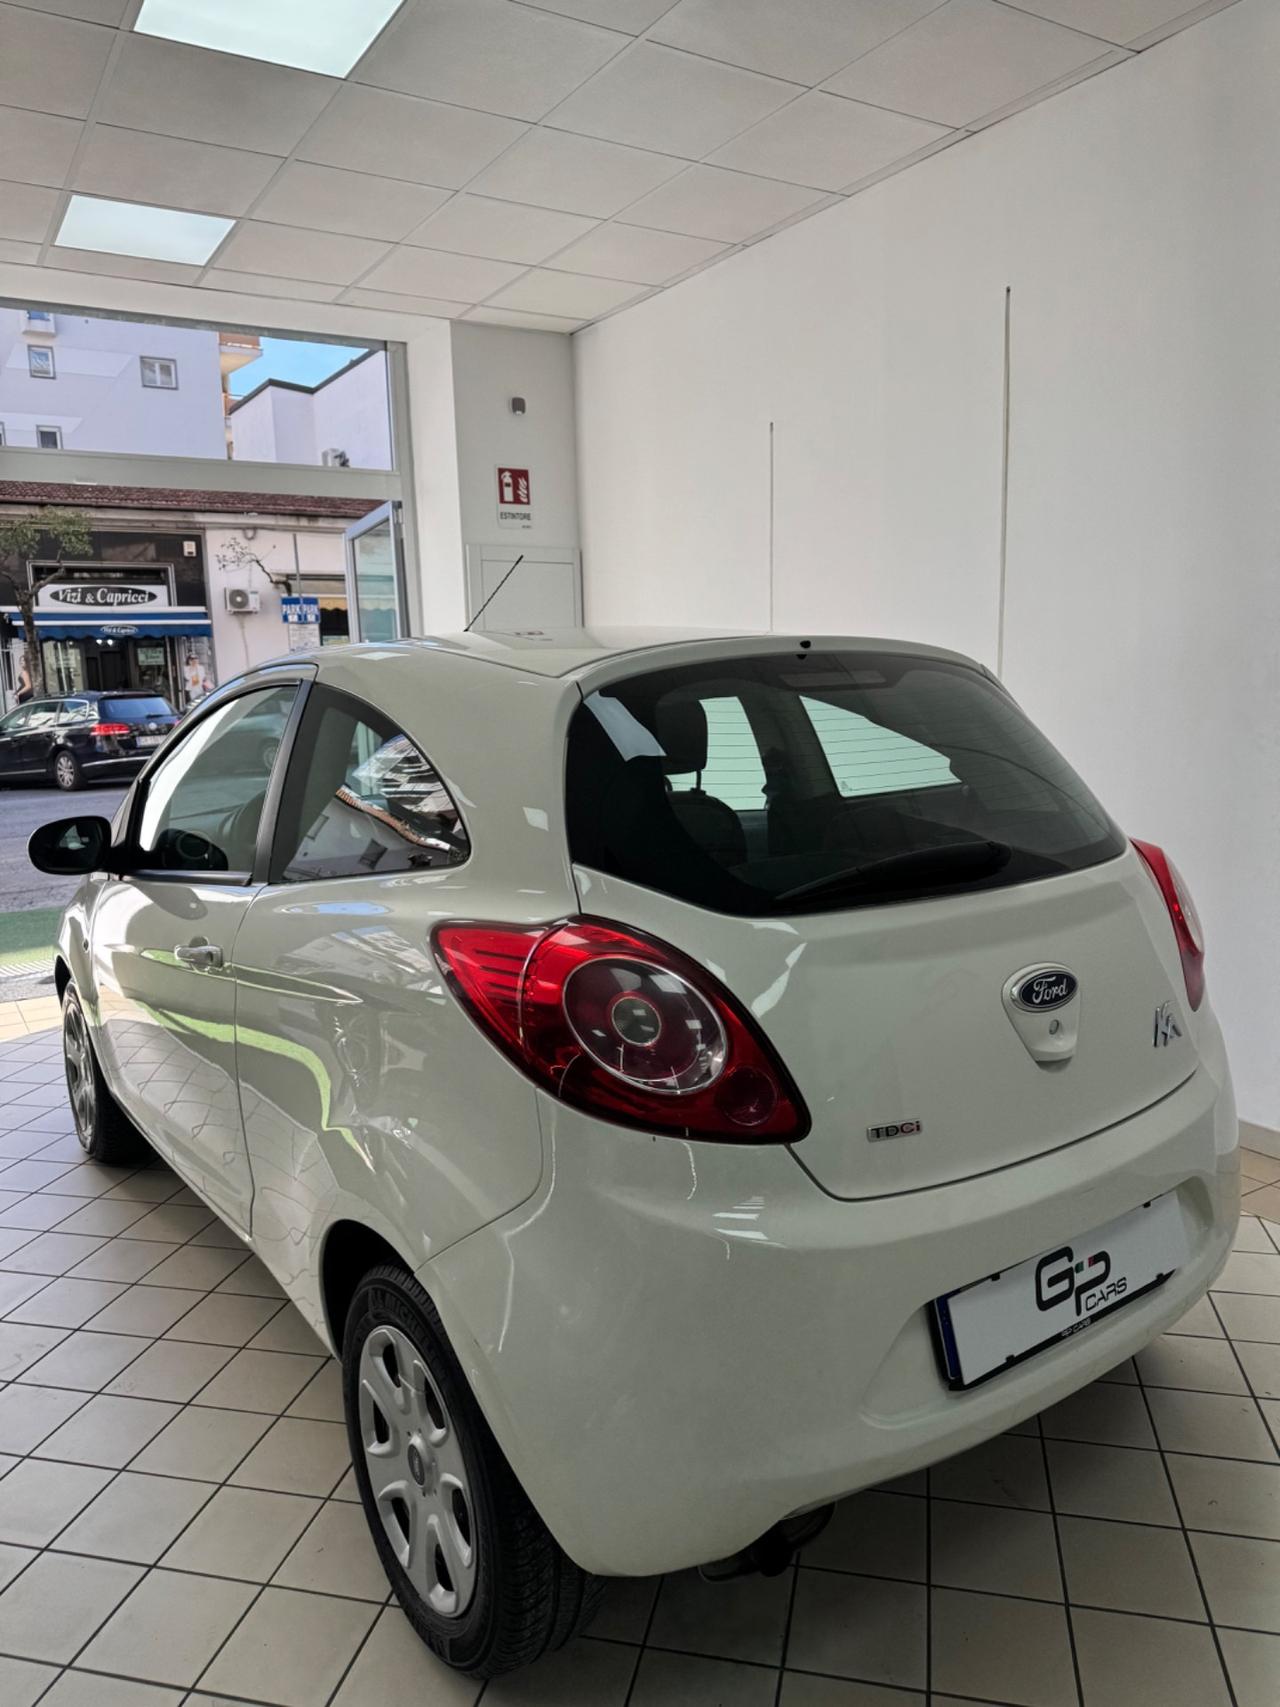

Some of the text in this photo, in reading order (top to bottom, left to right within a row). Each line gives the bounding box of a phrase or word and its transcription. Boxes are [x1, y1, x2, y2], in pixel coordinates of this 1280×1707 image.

[500, 511, 531, 520] ESTINTORE
[58, 588, 149, 606] Vizi & Capricci
[1032, 976, 1069, 1004] Ford
[870, 1120, 920, 1139] TDCi
[1035, 1246, 1111, 1316] GP
[1085, 1276, 1128, 1311] CARS
